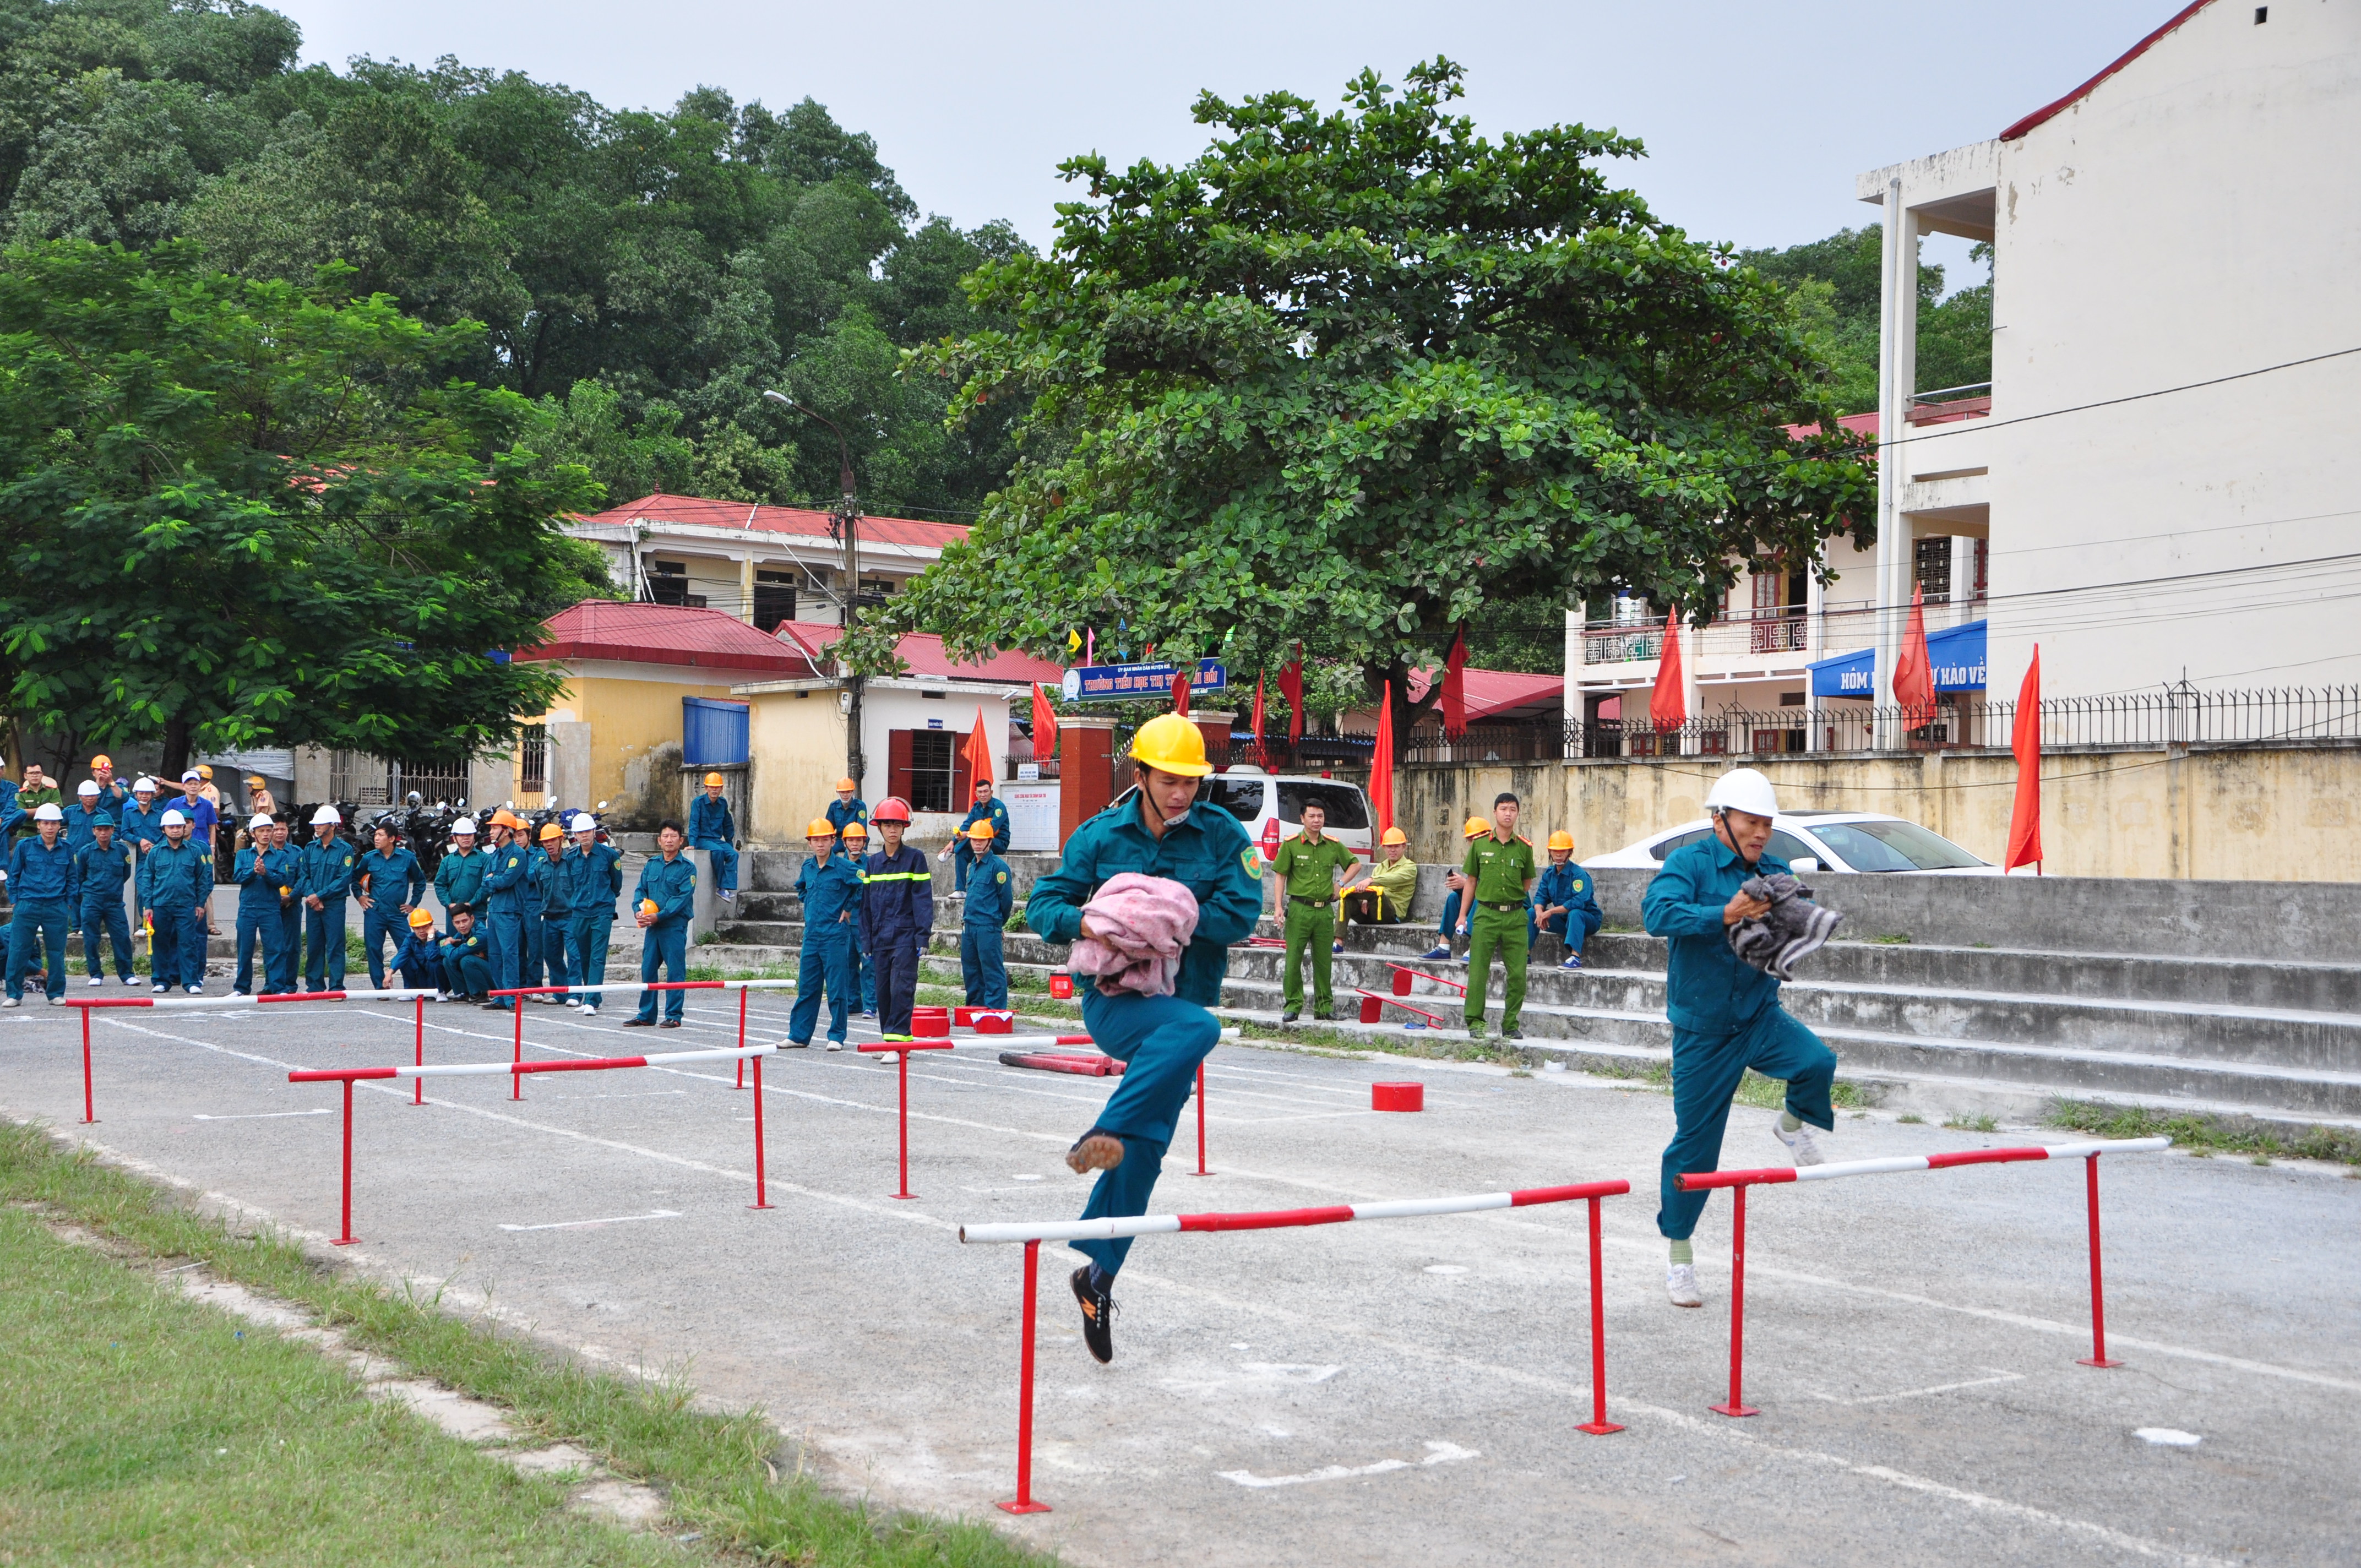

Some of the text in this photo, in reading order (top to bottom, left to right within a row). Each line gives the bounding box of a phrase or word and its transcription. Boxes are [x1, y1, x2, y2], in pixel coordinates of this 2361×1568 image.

[1084, 673, 1113, 691] TRƯỜNG
[1114, 672, 1133, 689] TIỂU
[1134, 676, 1149, 691] HỌC
[1150, 674, 1163, 689] THỊ
[1204, 665, 1218, 684] ĐỐI
[1841, 667, 1868, 690] HÔM
[1941, 662, 1967, 685] HÀO
[1968, 656, 1985, 684] VỀ
